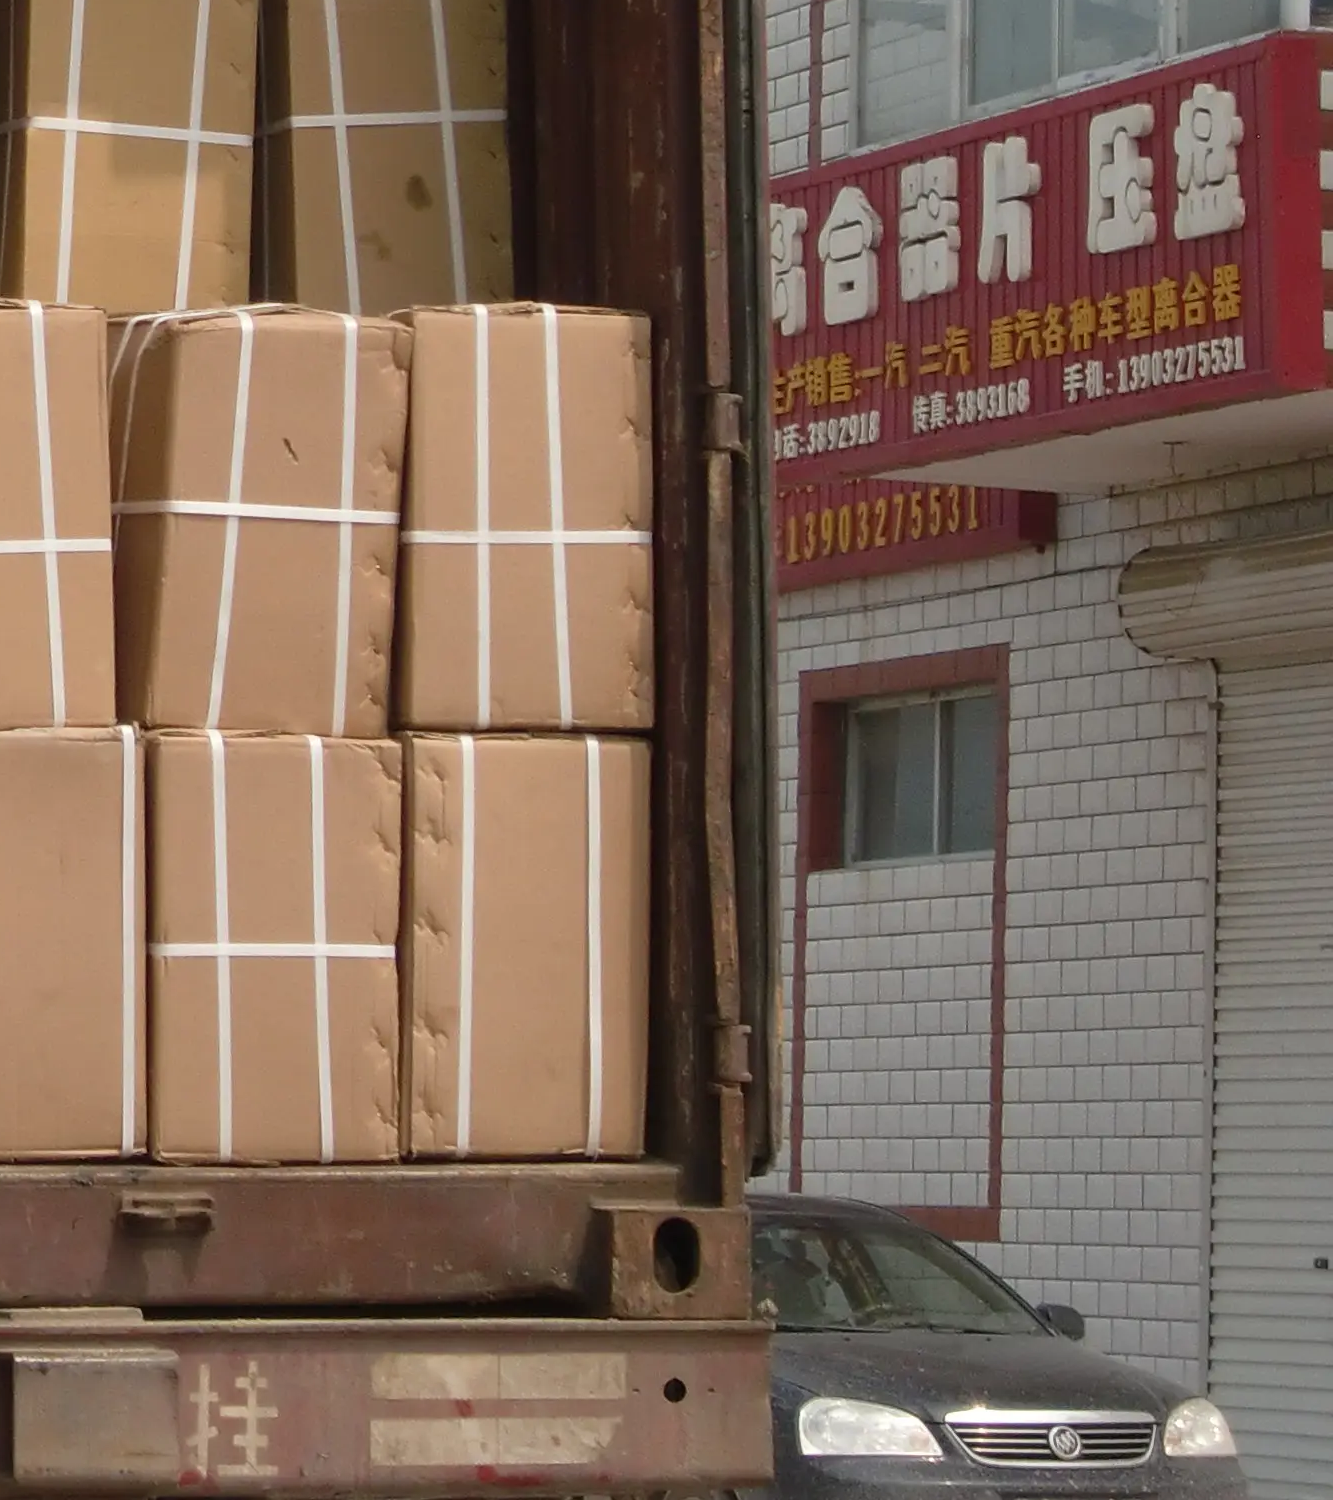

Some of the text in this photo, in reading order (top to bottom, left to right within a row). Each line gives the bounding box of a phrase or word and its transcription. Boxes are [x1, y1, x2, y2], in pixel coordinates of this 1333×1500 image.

[1086, 83, 1246, 255] 压盘
[785, 484, 979, 565] 13903275531
[185, 1359, 280, 1479] 挂
